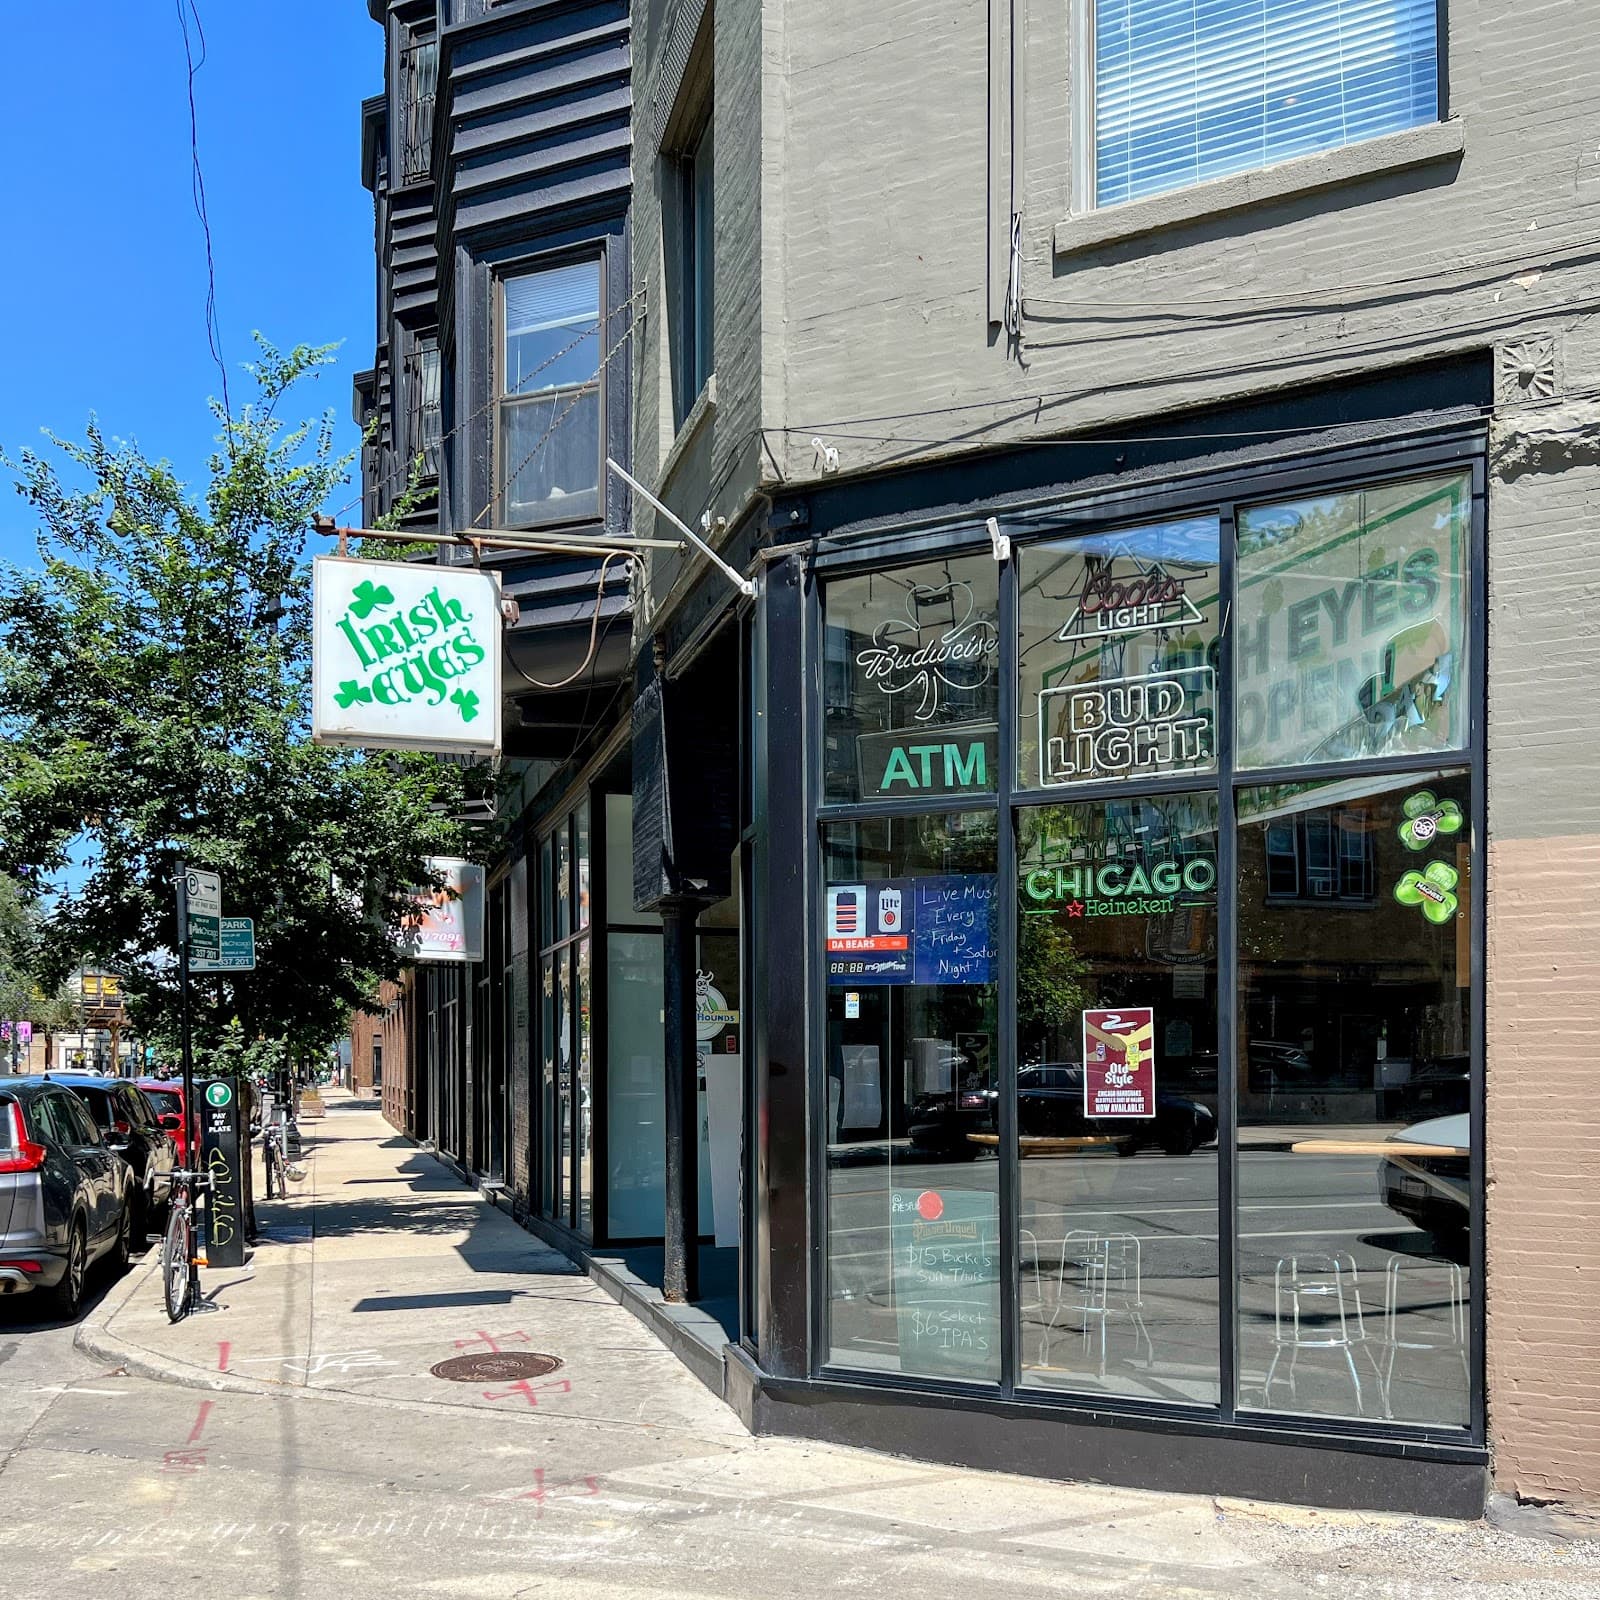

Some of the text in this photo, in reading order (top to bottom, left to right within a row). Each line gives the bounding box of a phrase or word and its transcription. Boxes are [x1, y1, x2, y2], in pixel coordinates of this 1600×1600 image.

[1286, 547, 1440, 662] EYES
[1097, 602, 1162, 630] LIGHT
[856, 634, 999, 679] Budweise
[1071, 681, 1184, 734] BUD
[880, 742, 987, 790] ATM
[1025, 858, 1216, 900] CHICAGO
[881, 898, 900, 910] Lite
[922, 885, 998, 905] Live Musi
[935, 907, 975, 927] Every
[1085, 897, 1173, 917] Heineken
[220, 921, 247, 929] PARK
[831, 940, 844, 949] DA
[845, 939, 875, 949] BEARS
[931, 931, 966, 947] Friday
[963, 945, 998, 959] Satur
[938, 959, 980, 979] Night!
[1109, 1062, 1129, 1074] Old
[1104, 1072, 1134, 1088] Style
[212, 1112, 226, 1120] PAY
[1096, 1104, 1110, 1113] NOW
[208, 1125, 232, 1133] PLATE
[911, 1308, 987, 1345] $6 Select
